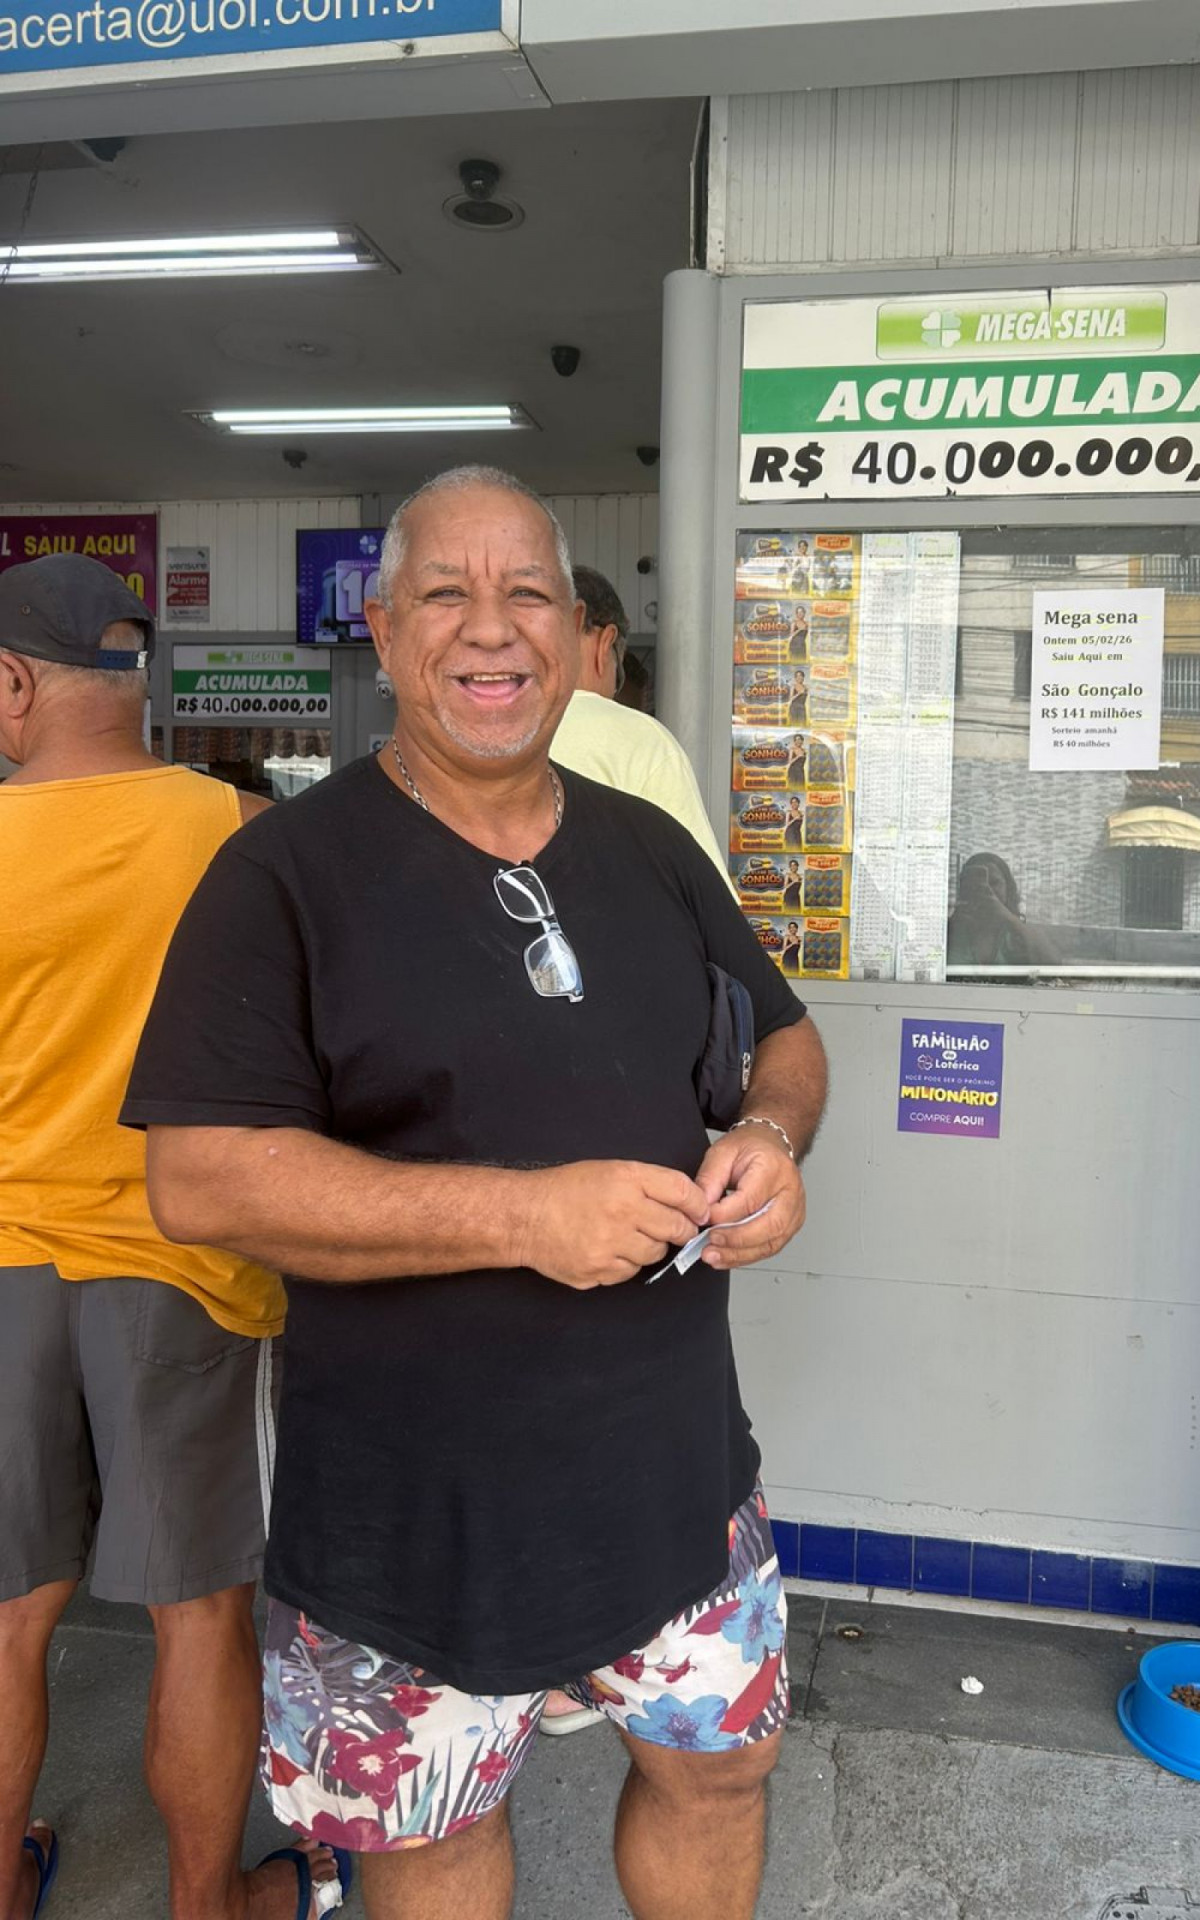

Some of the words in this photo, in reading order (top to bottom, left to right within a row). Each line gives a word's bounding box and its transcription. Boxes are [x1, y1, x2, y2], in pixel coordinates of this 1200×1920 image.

[0, 0, 435, 50] acerta@uol.com.
[749, 441, 826, 488] R$
[24, 535, 77, 556] SAIU
[82, 534, 137, 556] AQUI
[168, 574, 208, 586] Alarme
[1043, 610, 1092, 629] Mega
[1095, 611, 1139, 625] sena
[1043, 635, 1078, 646] Ontem
[1081, 635, 1133, 646] 05/02/26
[1051, 652, 1075, 662] Saiu
[1078, 652, 1103, 663] Aqui
[1107, 653, 1123, 661] em
[194, 674, 309, 691] ACUMULADA
[1041, 683, 1070, 697] São
[1078, 682, 1144, 700] Gonçalo
[176, 697, 199, 714] R$
[201, 697, 328, 715] 40.000.000,00
[1041, 707, 1059, 720] R$
[1062, 707, 1086, 719] 141
[1089, 707, 1143, 719] milhões
[1051, 726, 1082, 735] Sorteio
[1052, 739, 1065, 749] R$
[1065, 740, 1077, 748] 40
[744, 749, 787, 759] SONHOS
[742, 811, 784, 822] SONHOS
[740, 873, 783, 885] SONHOS
[935, 1059, 980, 1071] Lotérica
[900, 1085, 999, 1107] MILIONÁRIO
[909, 1111, 951, 1124] COMPRE
[953, 1115, 985, 1126] AQUI!
